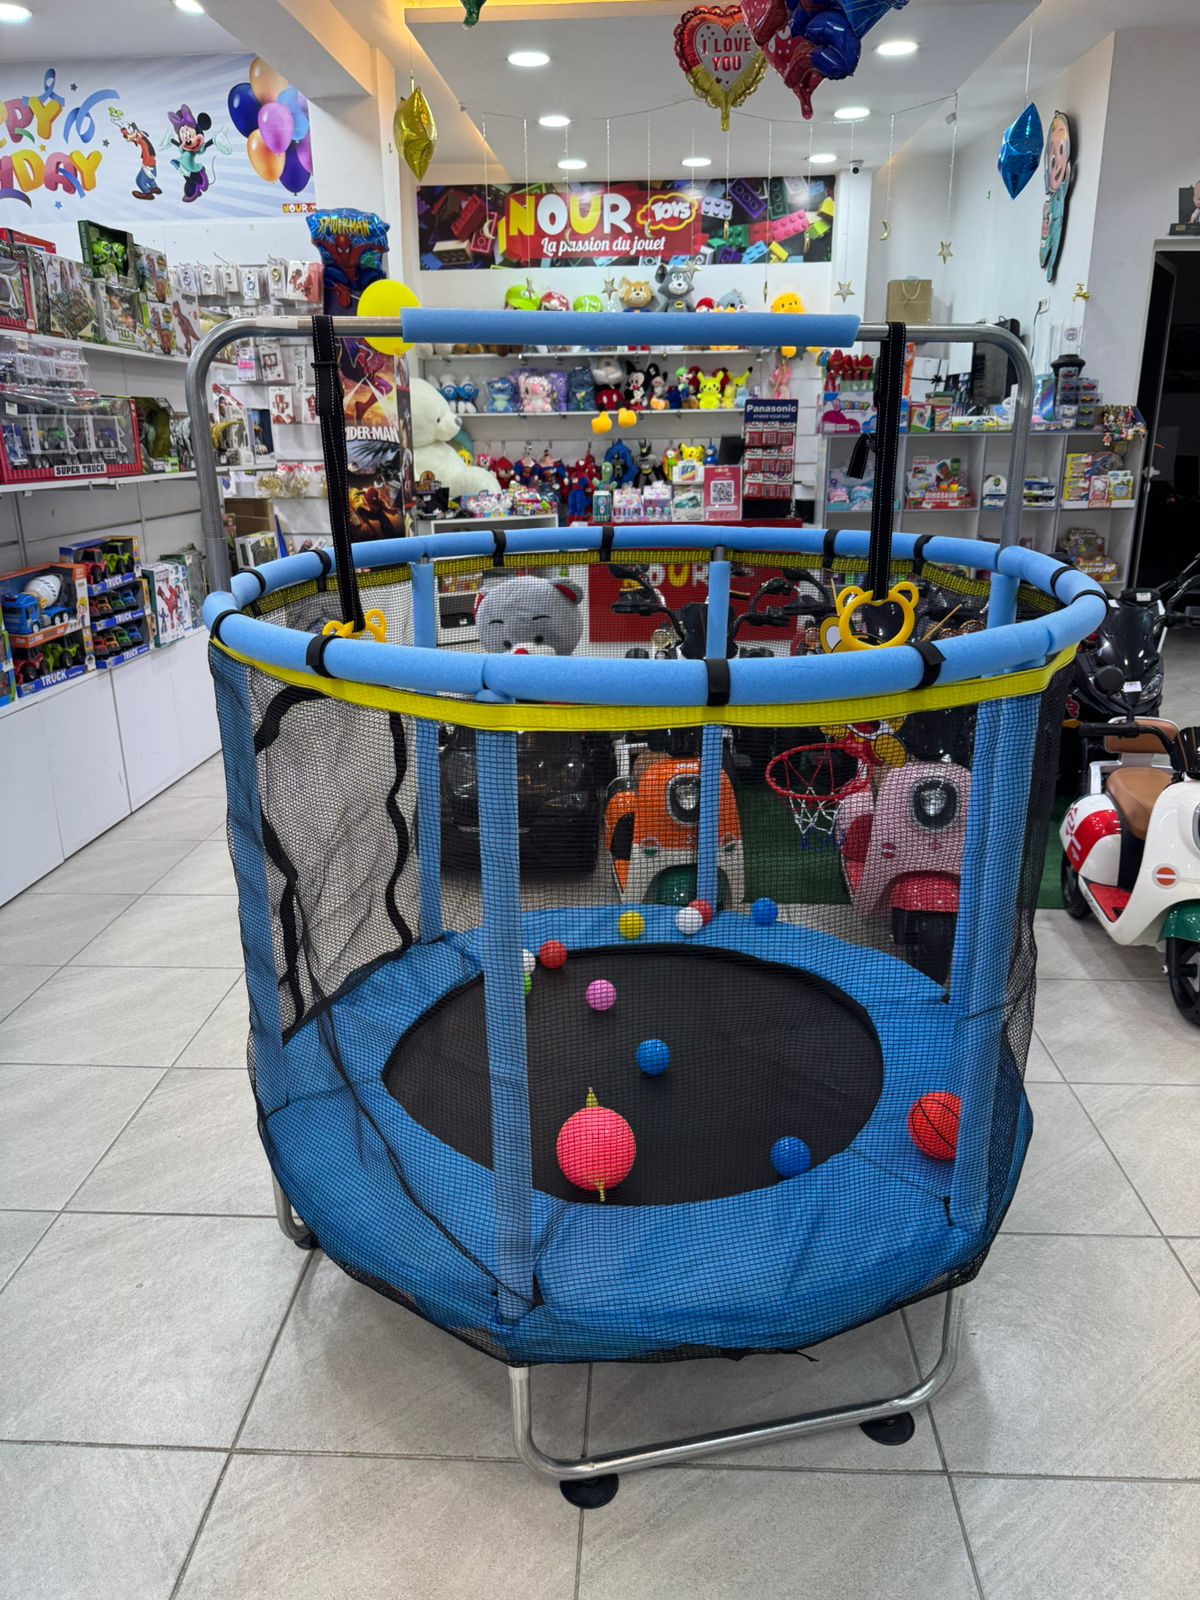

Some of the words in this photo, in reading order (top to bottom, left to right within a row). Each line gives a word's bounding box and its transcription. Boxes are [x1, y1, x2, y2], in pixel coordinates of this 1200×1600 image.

[702, 40, 707, 54] I
[714, 37, 751, 53] LOVE
[712, 56, 742, 71] YOU
[0, 96, 62, 143] PY
[282, 203, 308, 213] NOUR
[509, 193, 633, 235] NOUR
[651, 201, 692, 222] TOYS
[541, 238, 557, 256] La
[558, 237, 610, 256] passion
[612, 237, 631, 251] du
[630, 236, 666, 255] jouet
[746, 404, 797, 413] Panasonic
[345, 425, 400, 443] IDER-MAN
[55, 466, 81, 476] SUPER
[83, 464, 106, 475] TRUCK
[925, 491, 958, 499] DINOSAUR
[105, 575, 122, 588] TRUCK
[115, 612, 132, 624] TRUCK
[123, 649, 139, 660] TRUCK
[41, 668, 67, 687] TRUCK
